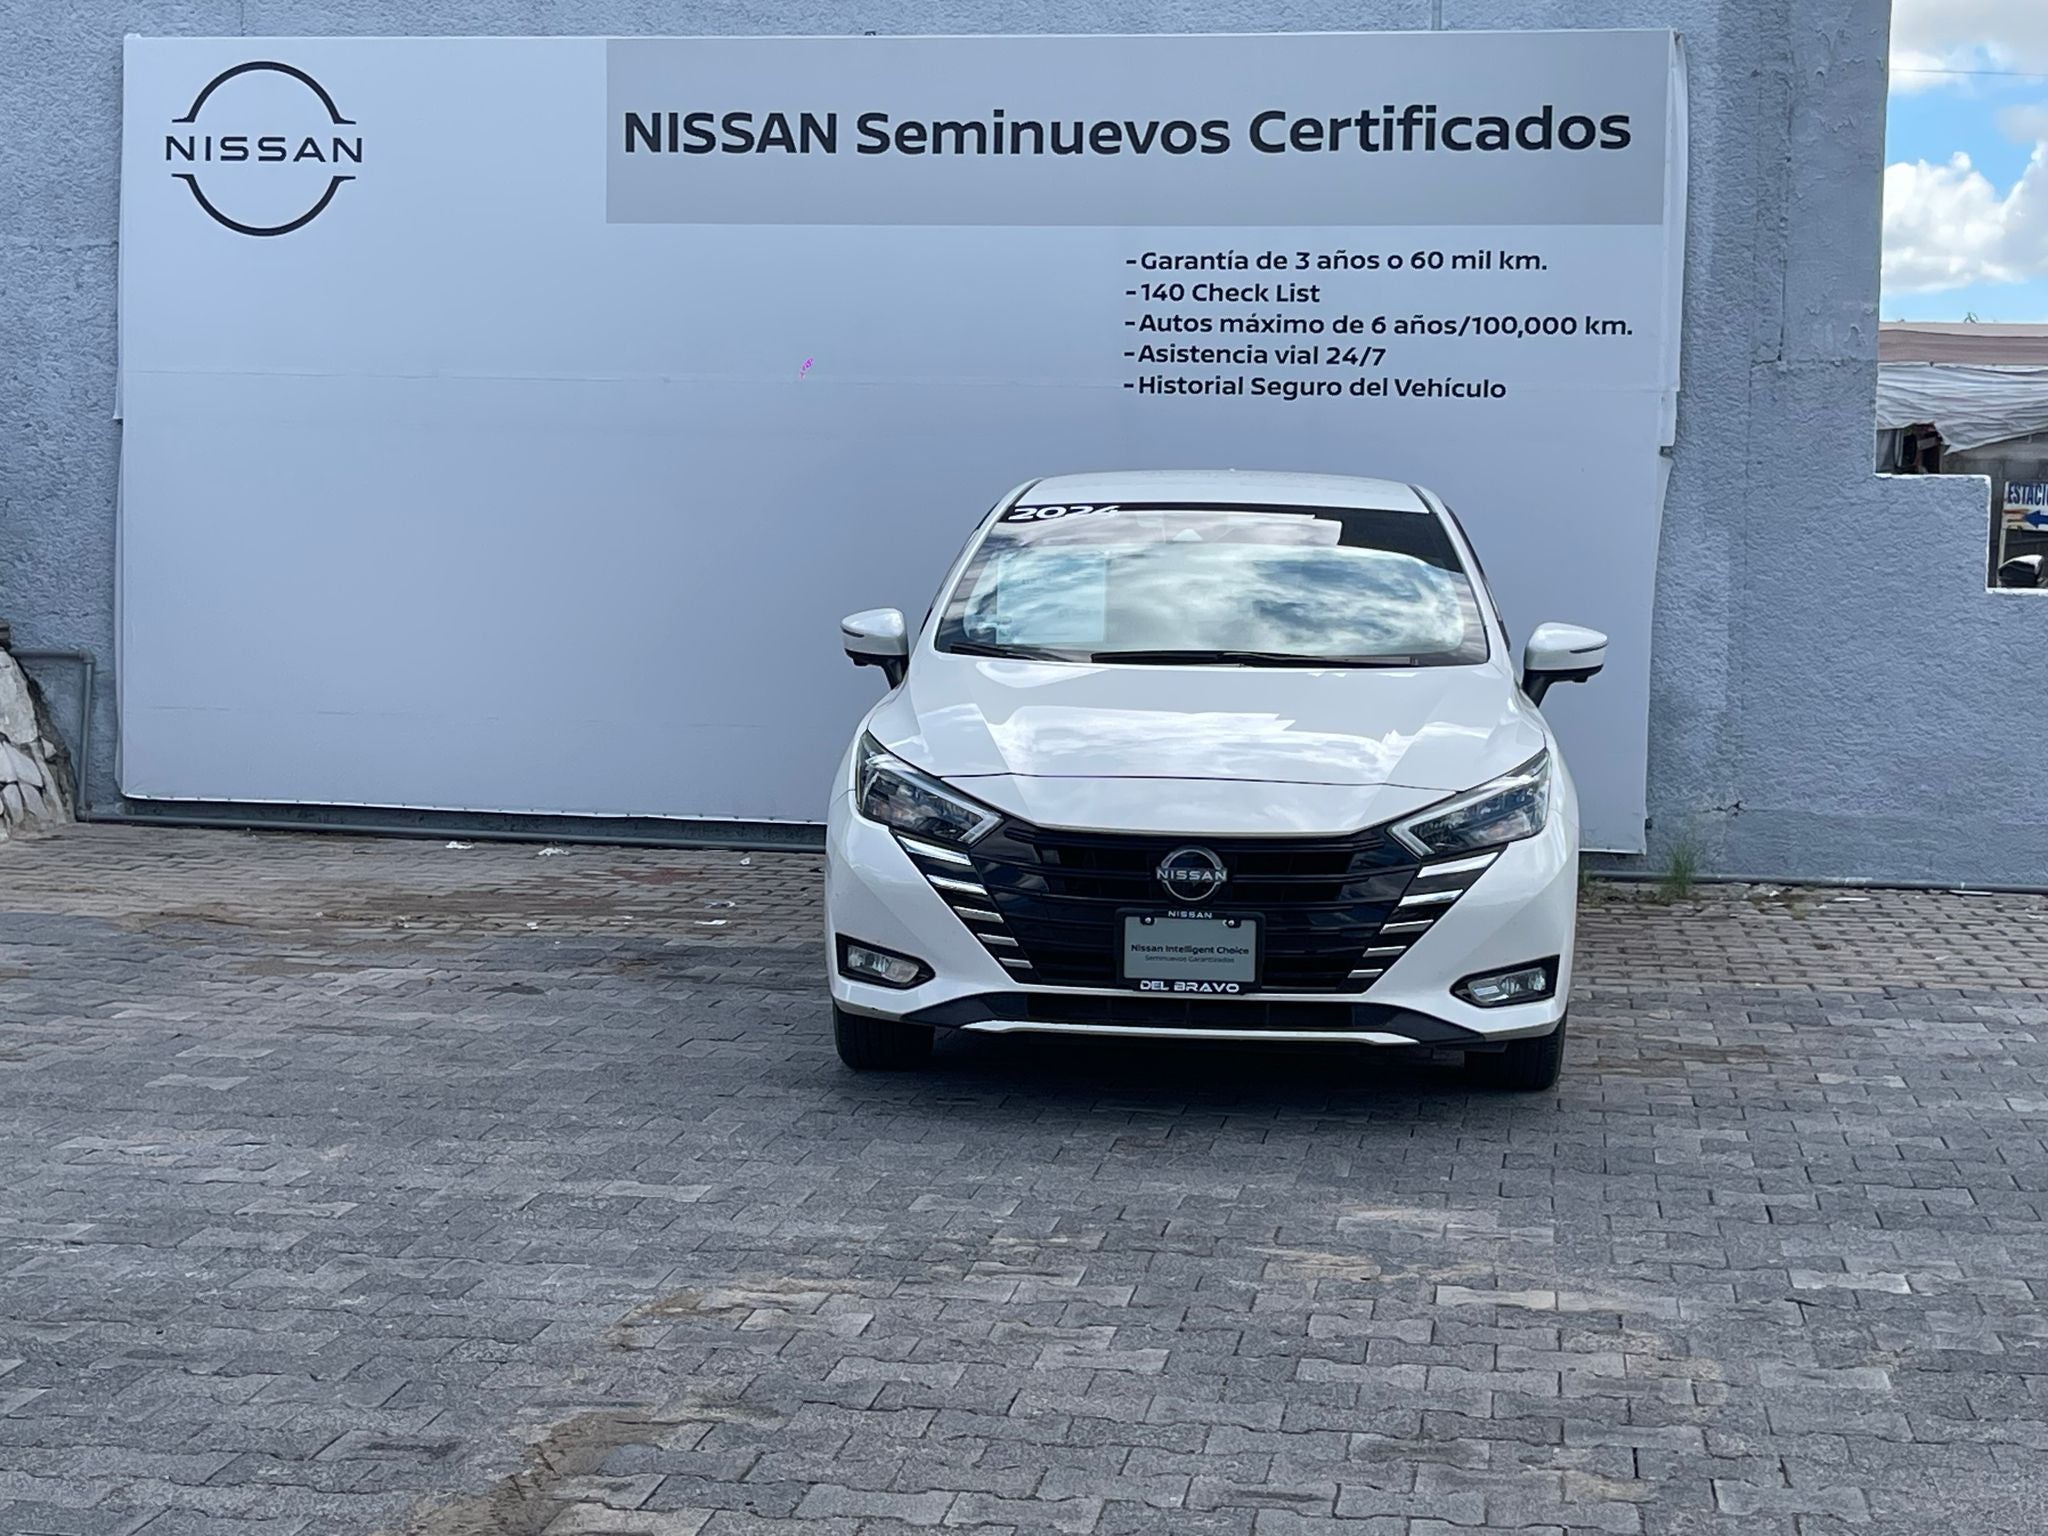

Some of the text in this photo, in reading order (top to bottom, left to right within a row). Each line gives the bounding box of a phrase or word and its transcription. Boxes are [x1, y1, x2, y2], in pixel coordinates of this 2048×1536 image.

[625, 104, 1632, 154] NISSAN Seminuevos Certificados
[166, 135, 362, 162] NISSAN
[1256, 250, 1288, 270] de
[1295, 251, 1311, 270] 3
[1316, 249, 1380, 270] años
[1387, 254, 1404, 270] o
[1410, 250, 1444, 270] 60
[1451, 249, 1492, 270] mil
[1499, 250, 1547, 271] km.
[1192, 282, 1270, 303] Check
[1276, 282, 1321, 303] List
[1219, 312, 1325, 334] máximo
[1332, 314, 1364, 334] de
[1371, 315, 1387, 335] 6
[1393, 314, 1578, 339] años/100,000
[1585, 315, 1633, 336] km.
[1274, 344, 1319, 365] vial
[1325, 346, 1387, 368] 24/7
[1250, 376, 1342, 401] Seguro
[1349, 377, 1388, 397] del
[1394, 376, 1507, 399] Vehículo
[2008, 482, 2048, 506] ESTACI
[1156, 869, 1227, 881] NISSAN
[1168, 911, 1213, 919] NISSAN
[1131, 944, 1249, 955] Nissan Intelligent Choice
[1140, 980, 1240, 993] DEL BRAVO
